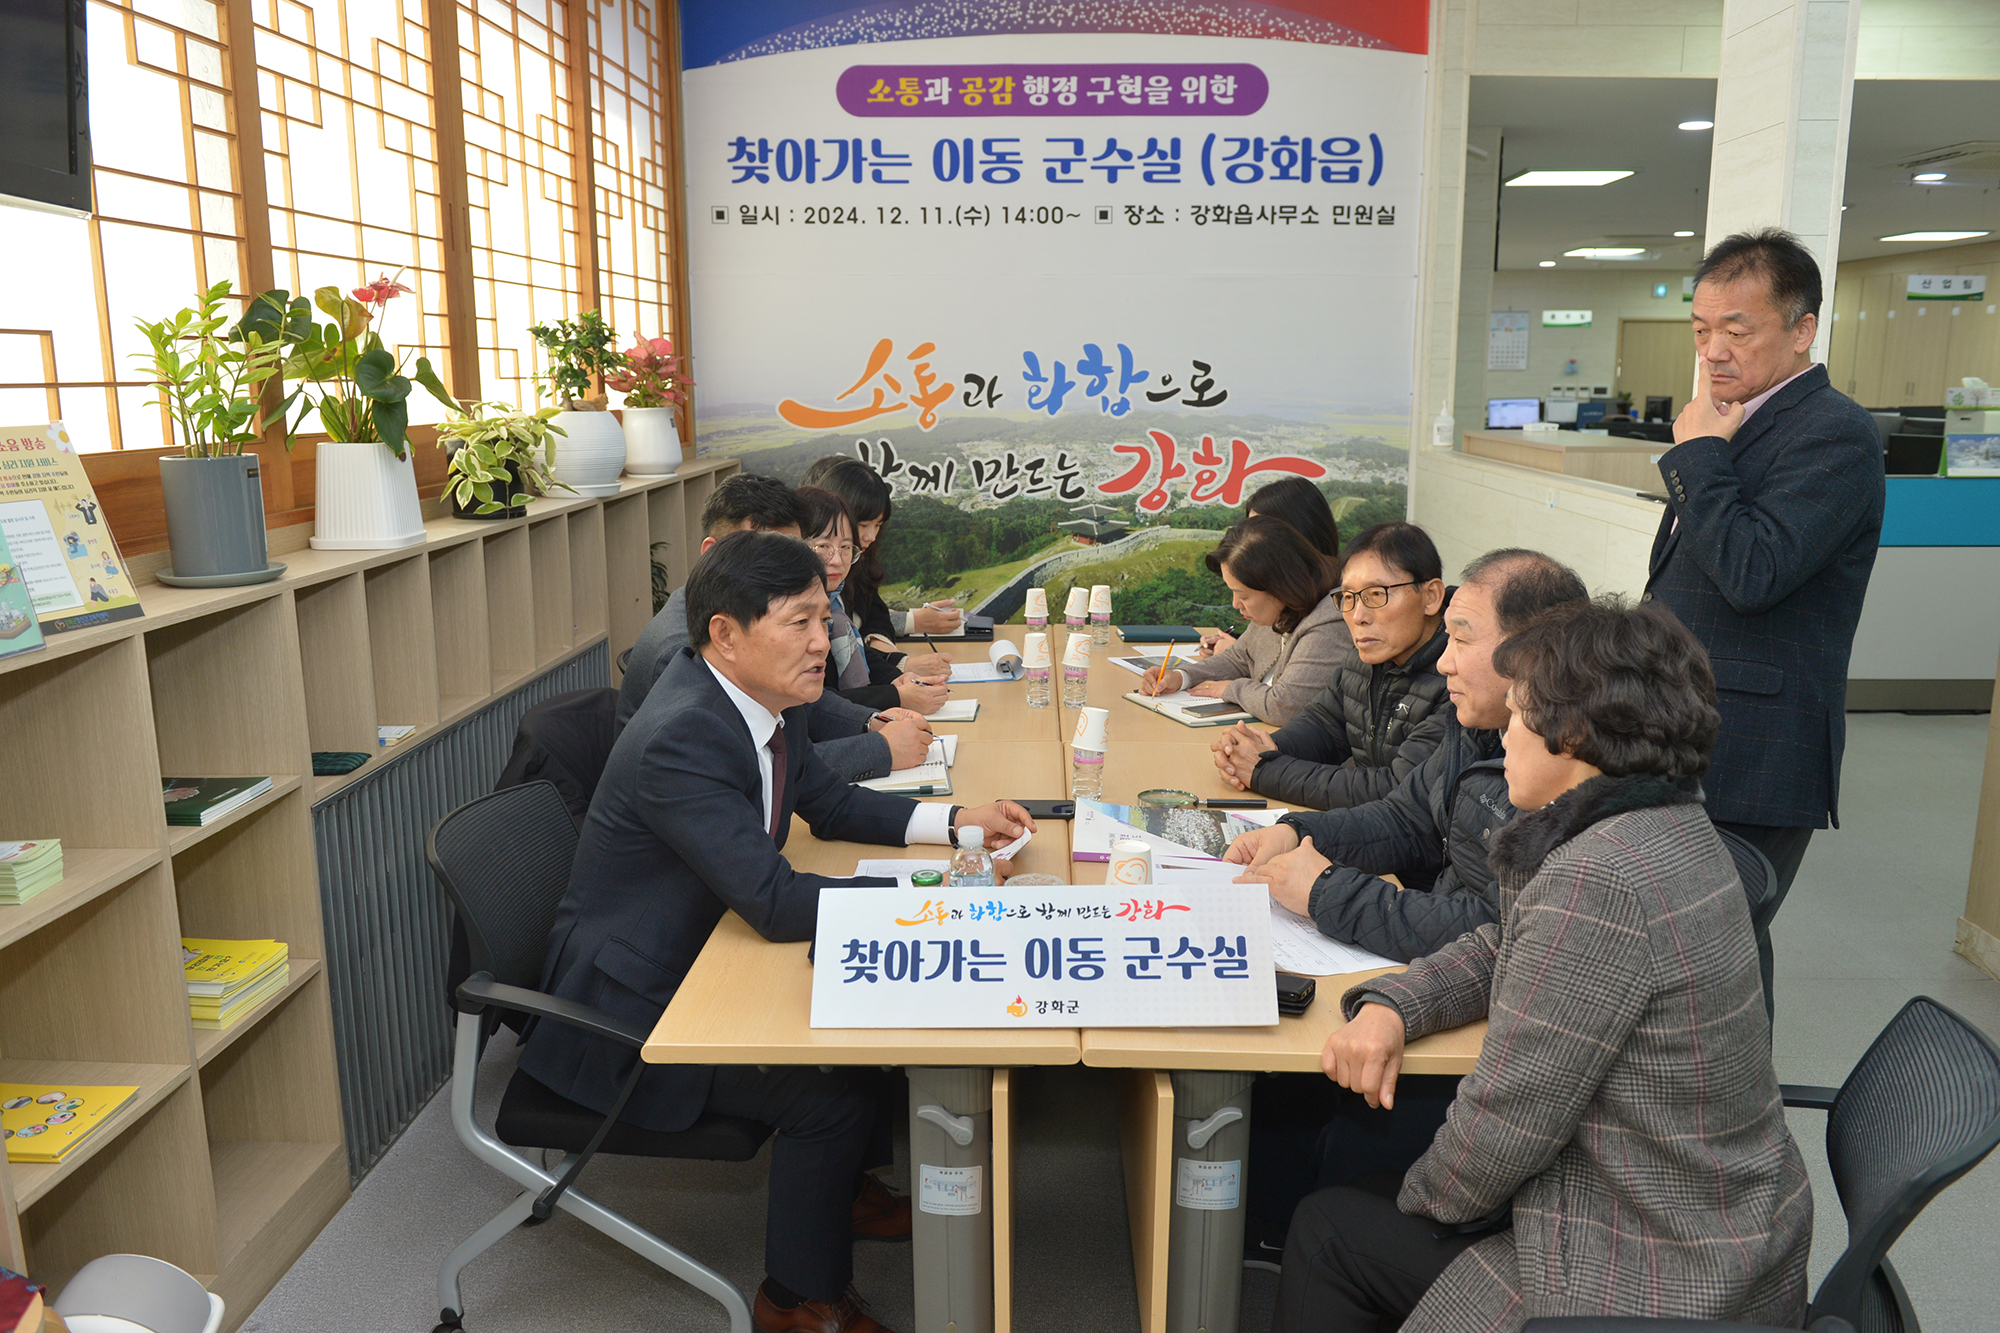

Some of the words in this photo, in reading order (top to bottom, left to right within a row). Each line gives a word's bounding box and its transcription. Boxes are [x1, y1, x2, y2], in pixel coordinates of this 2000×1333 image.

[866, 77, 952, 106] 소통과
[958, 76, 1016, 106] 공감
[1022, 75, 1078, 106] 행정
[1086, 75, 1172, 105] 구현을
[1180, 75, 1238, 105] 위한
[727, 136, 913, 184] 찾아가는
[932, 137, 1023, 184] 이동
[1043, 137, 1181, 184] 군수실
[1201, 132, 1384, 187] (강화읍)
[739, 205, 780, 226] 일시
[804, 206, 866, 225] 2024.
[876, 206, 909, 225] 12.
[1001, 206, 1081, 225] 14:00~
[1124, 205, 1165, 226] 장소
[1190, 204, 1320, 226] 강화읍사무소
[1332, 205, 1396, 226] 민원실
[778, 338, 1004, 430] 소통과
[1022, 342, 1228, 416] 화합으로
[20, 437, 46, 451] 방송
[18, 459, 35, 469] 지원
[36, 457, 59, 467] 서비스
[972, 453, 1085, 499] 만드는
[1098, 430, 1327, 510] 강화
[895, 900, 964, 927] 소통과
[969, 900, 1031, 922] 화합으로
[1035, 902, 1072, 921] 함께
[1076, 905, 1112, 919] 만드는
[1115, 898, 1192, 922] 강화
[840, 938, 1007, 984] 찾아가는
[1025, 937, 1107, 981] 이동
[1122, 935, 1250, 980] 군수실
[1035, 1000, 1080, 1015] 강화군
